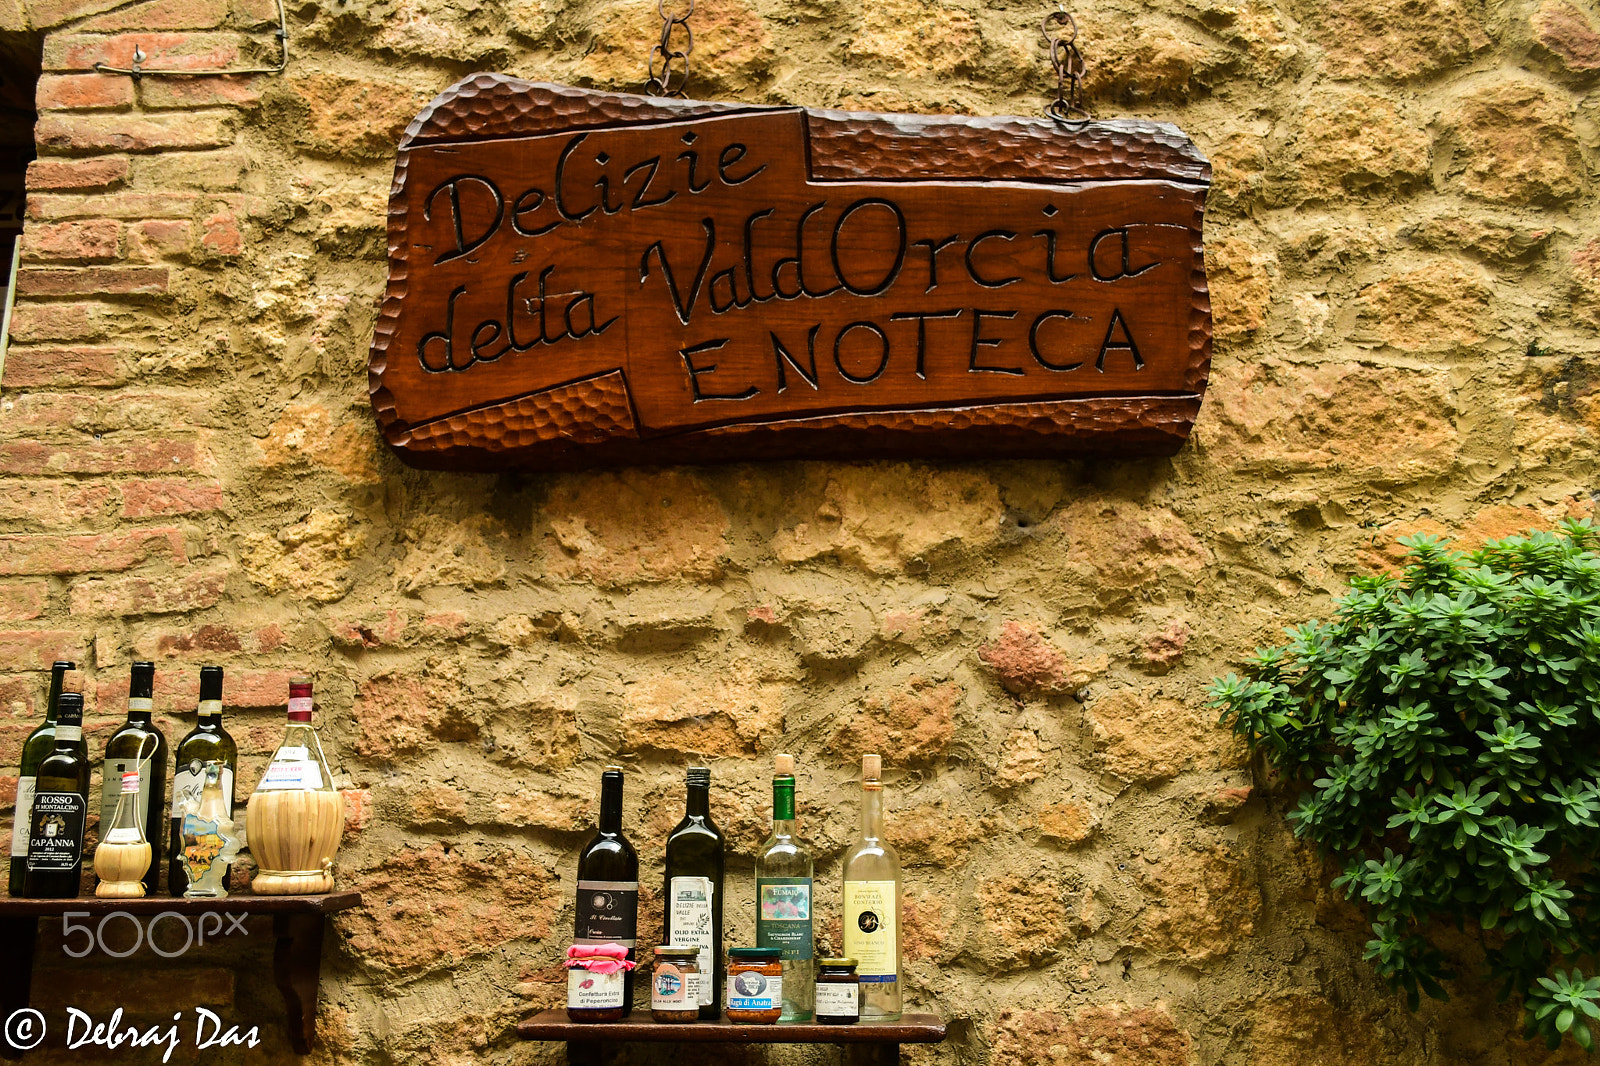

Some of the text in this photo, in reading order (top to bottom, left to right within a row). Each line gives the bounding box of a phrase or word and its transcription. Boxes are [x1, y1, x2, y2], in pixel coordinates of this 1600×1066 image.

[423, 131, 768, 266] Delizie
[679, 307, 1146, 405] ENOTECA
[41, 795, 73, 805] ROSSO
[30, 837, 75, 847] CAPANNA
